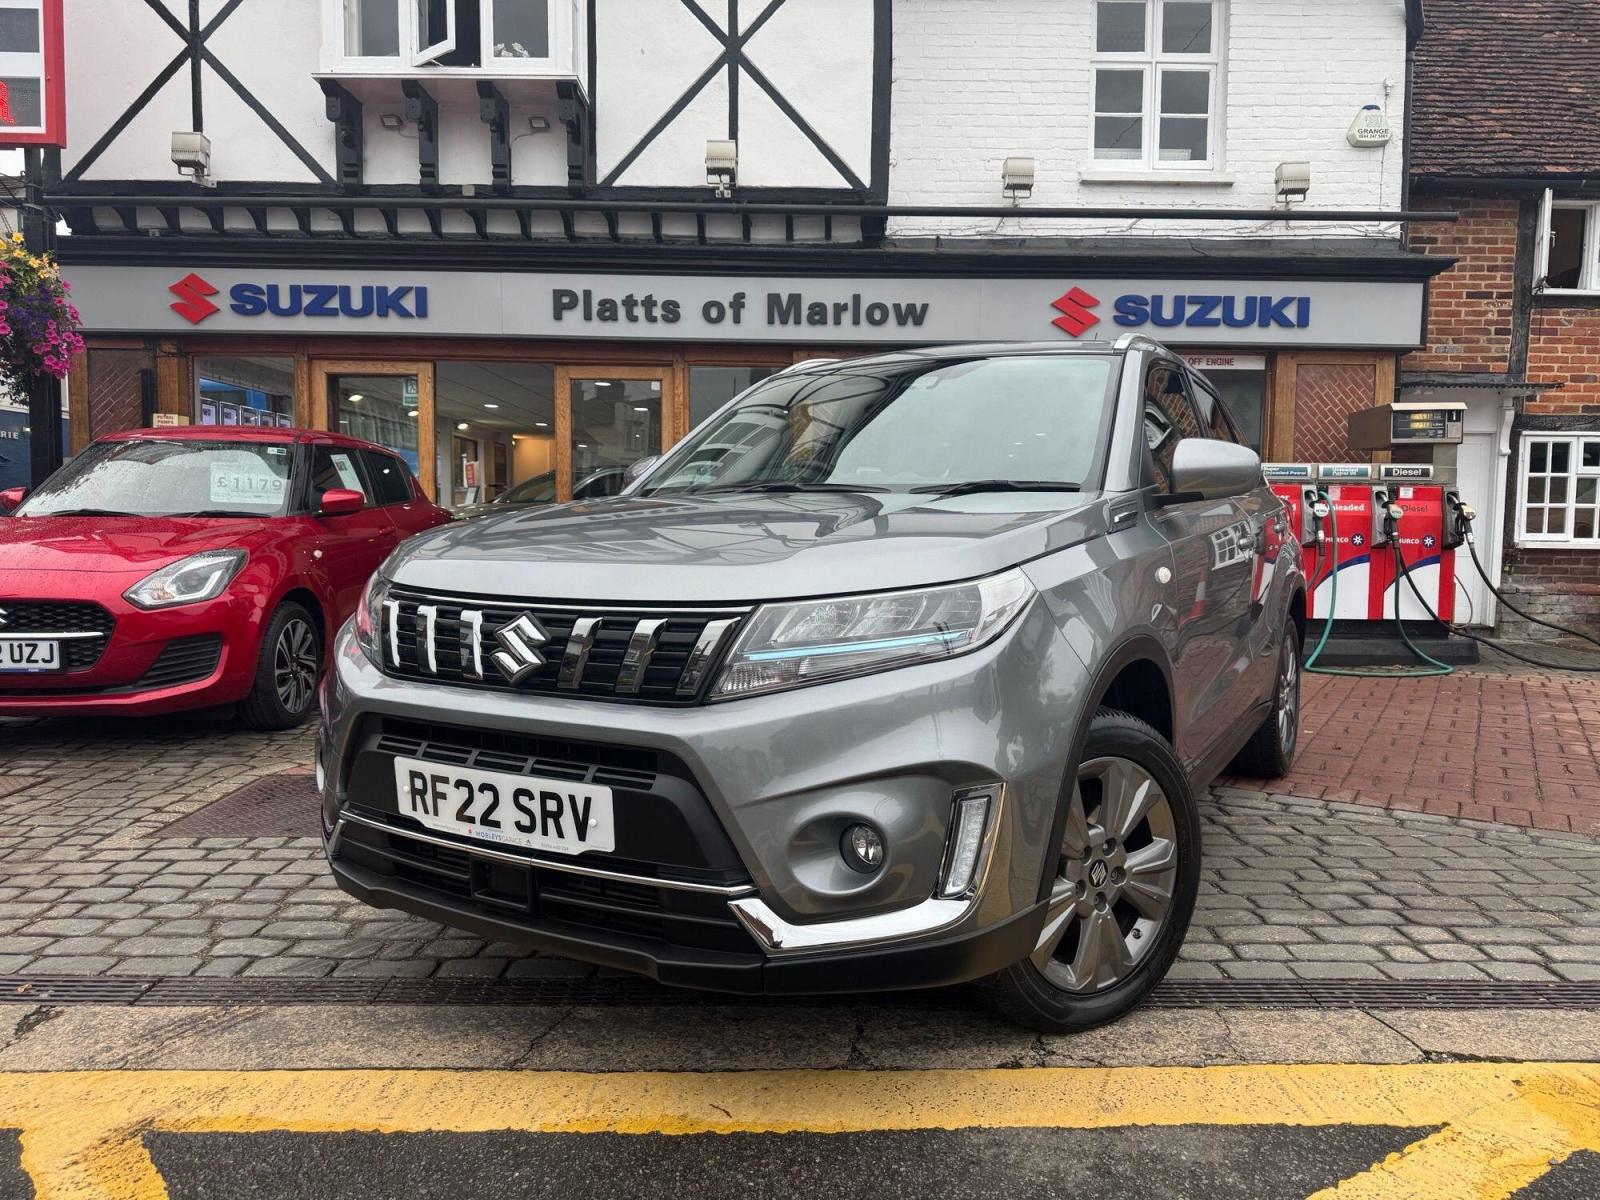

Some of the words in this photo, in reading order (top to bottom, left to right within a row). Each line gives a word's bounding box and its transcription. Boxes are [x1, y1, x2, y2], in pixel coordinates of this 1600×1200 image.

[229, 283, 428, 318] SUZUKI
[552, 289, 681, 323] Platts
[702, 292, 746, 324] of
[767, 293, 930, 326] Marlow
[1113, 293, 1311, 329] SUZUKI
[1206, 357, 1234, 366] ENGINE
[1392, 468, 1422, 476] Diesel
[1401, 504, 1428, 513] Diesel
[9, 643, 54, 664] UZJ
[409, 769, 502, 829] RF22
[512, 787, 592, 842] SRV
